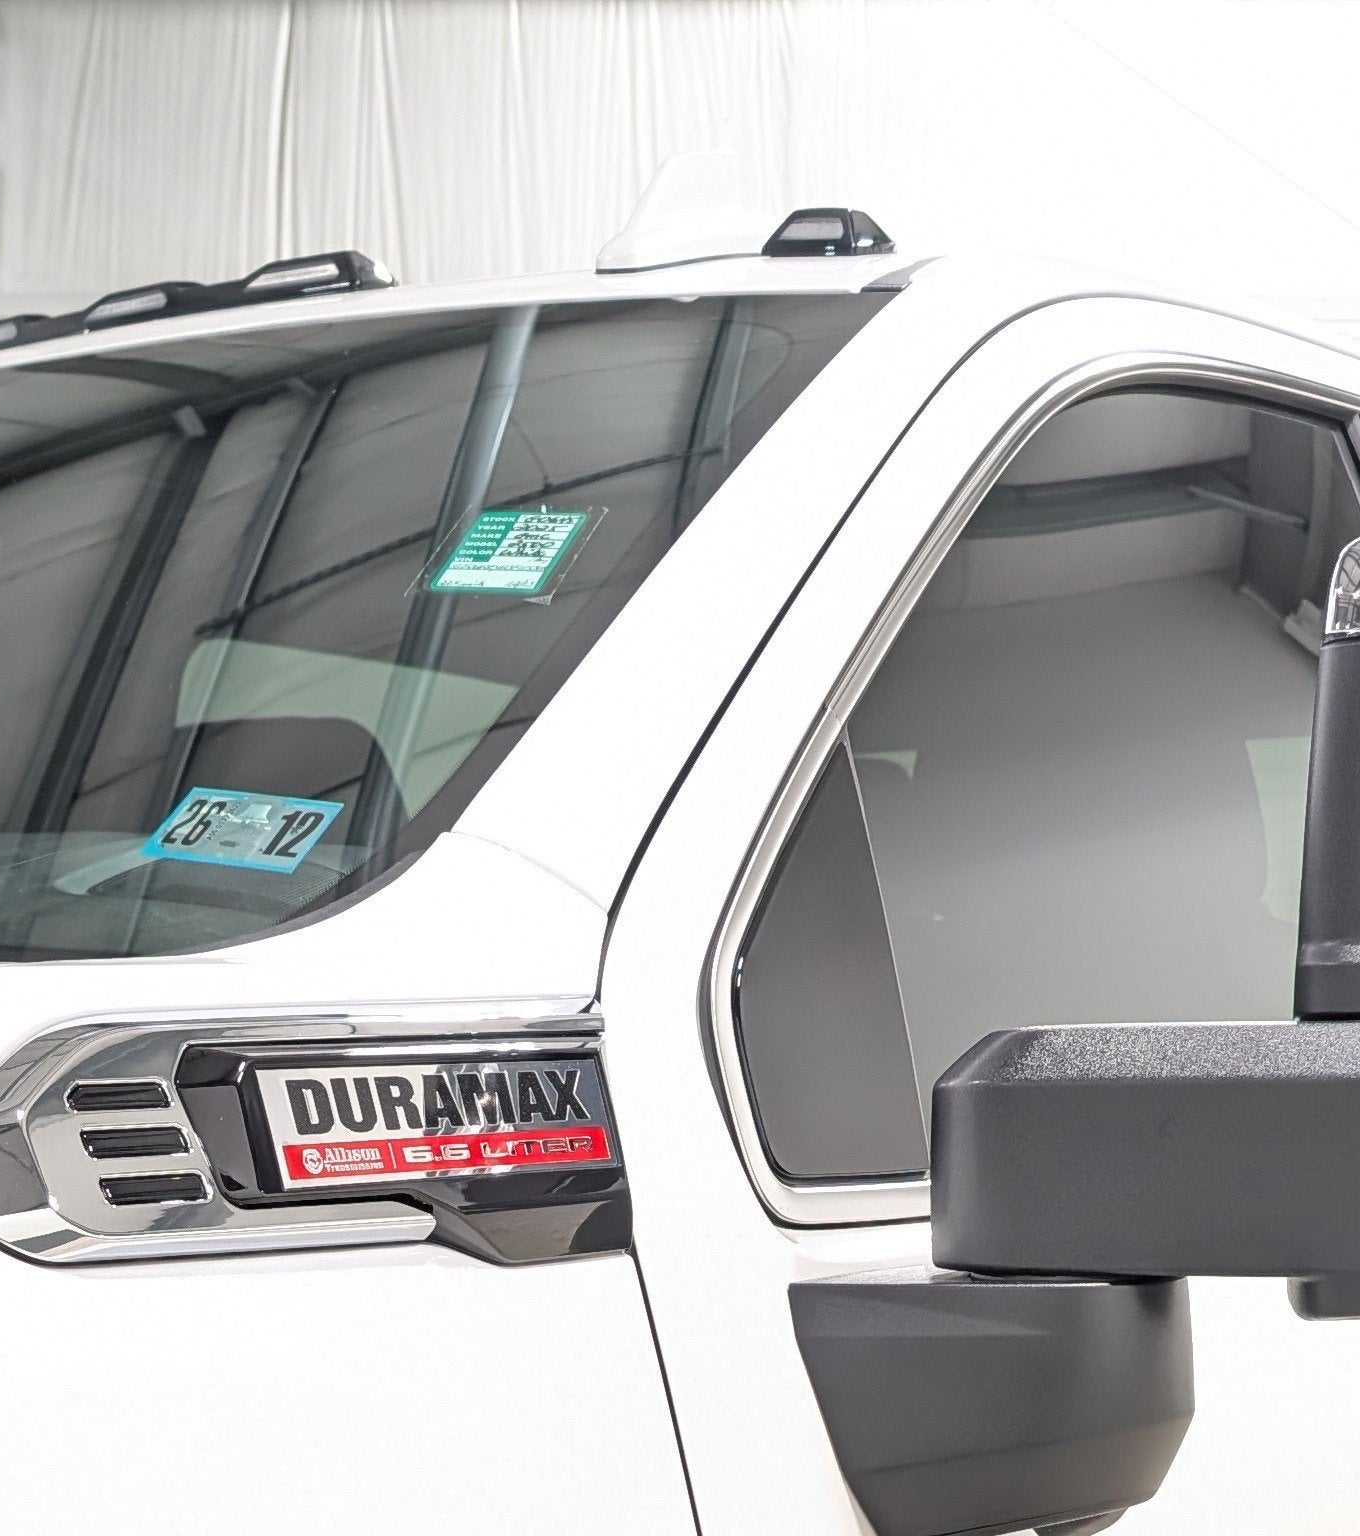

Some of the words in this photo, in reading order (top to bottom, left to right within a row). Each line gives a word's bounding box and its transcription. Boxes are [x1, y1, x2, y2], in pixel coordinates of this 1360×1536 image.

[161, 798, 228, 847] 26
[261, 809, 326, 859] 12
[285, 1070, 591, 1136] DURAMAX
[323, 1147, 381, 1163] Allison
[401, 1143, 471, 1164] 6.6
[482, 1135, 594, 1159] LITER
